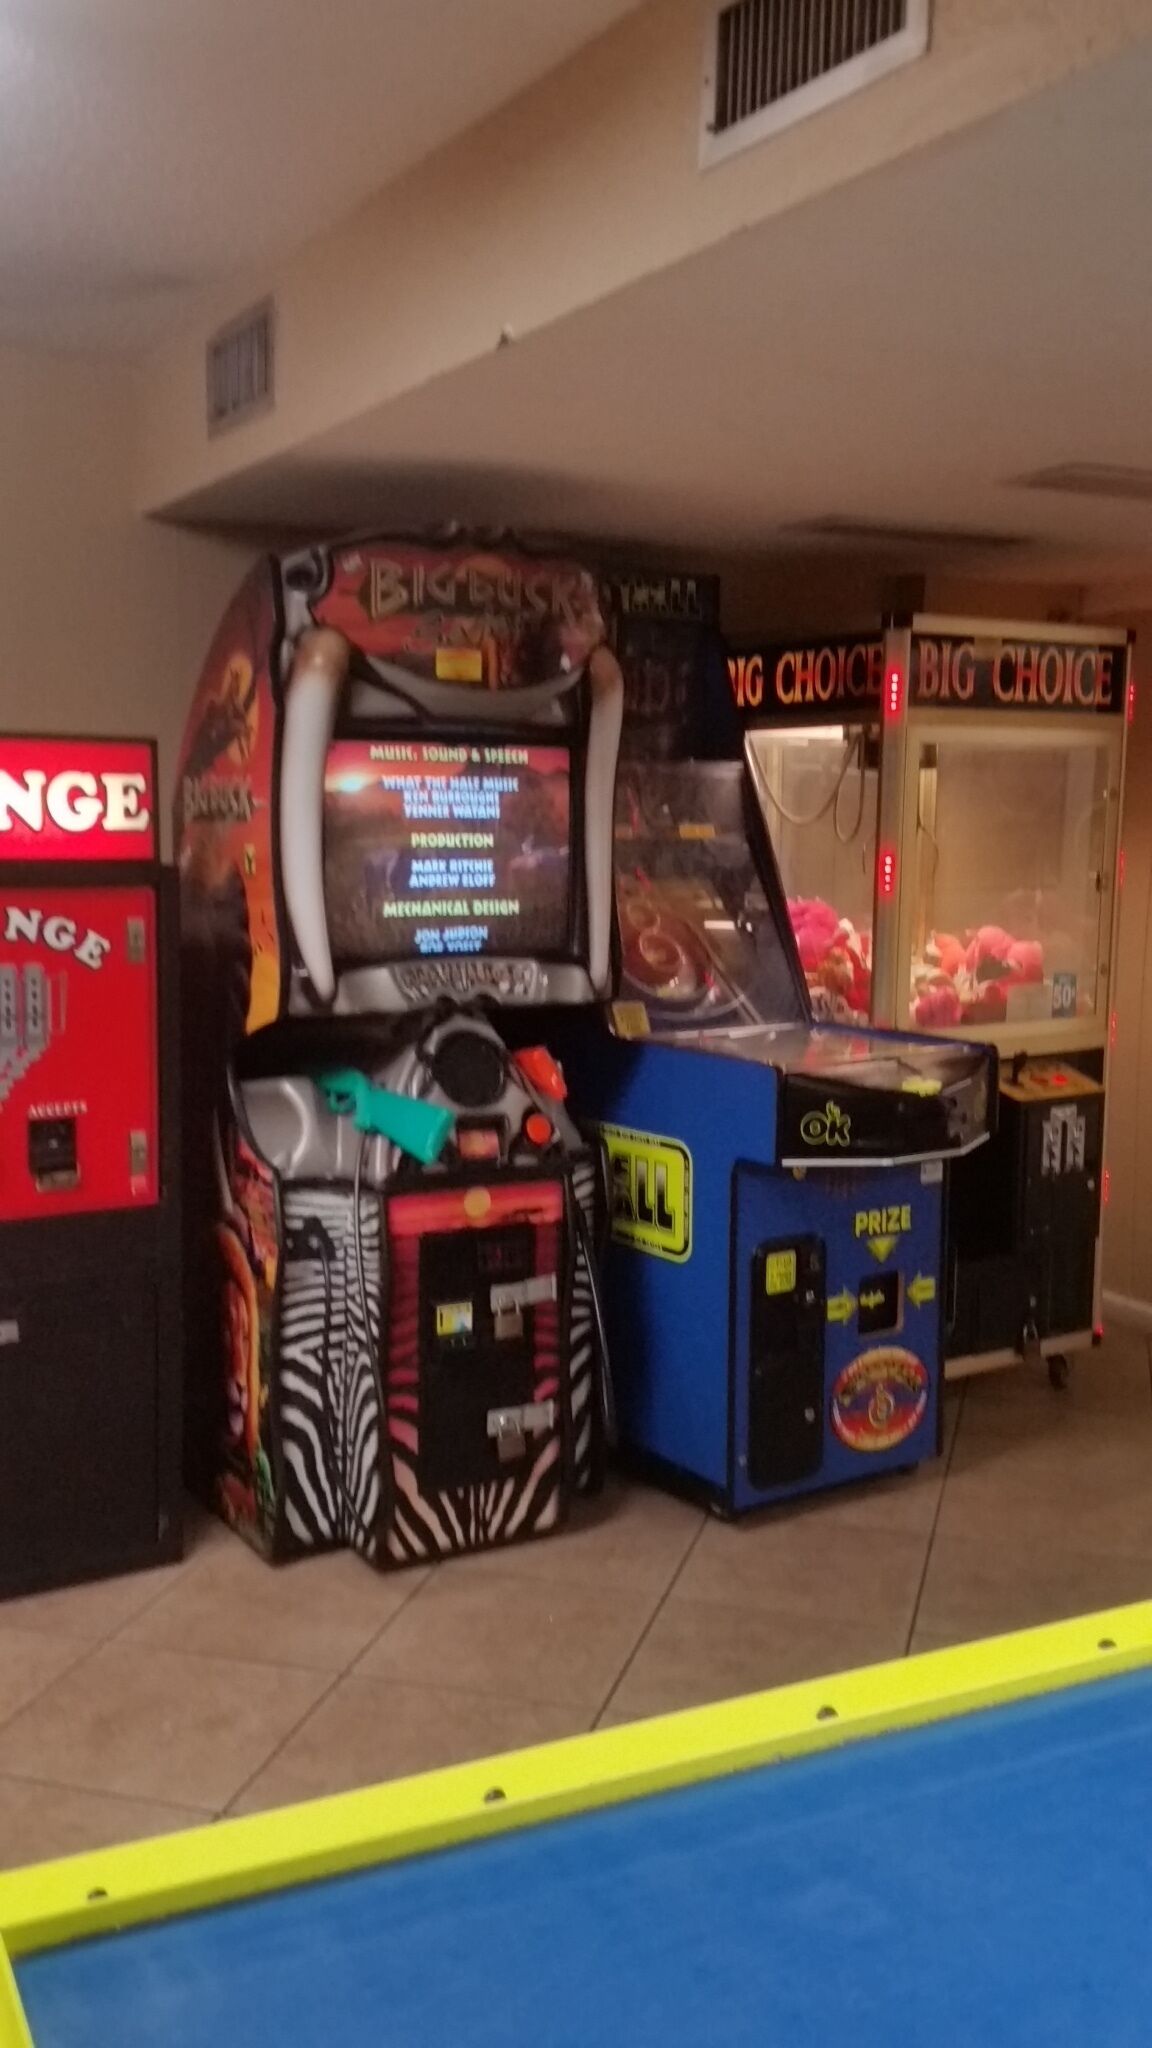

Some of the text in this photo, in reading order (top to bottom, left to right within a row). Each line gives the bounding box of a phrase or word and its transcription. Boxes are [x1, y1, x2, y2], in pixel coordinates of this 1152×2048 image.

[776, 642, 884, 704] CHOICE
[918, 639, 1113, 705] BIG CHOICE
[422, 746, 467, 763] SOUND
[411, 832, 494, 848] PRODUCTION
[412, 859, 447, 873] MARK
[409, 874, 460, 888] ANDREW
[383, 899, 520, 918] MECHANICAL DESIGN
[855, 1204, 912, 1238] PRIZE
